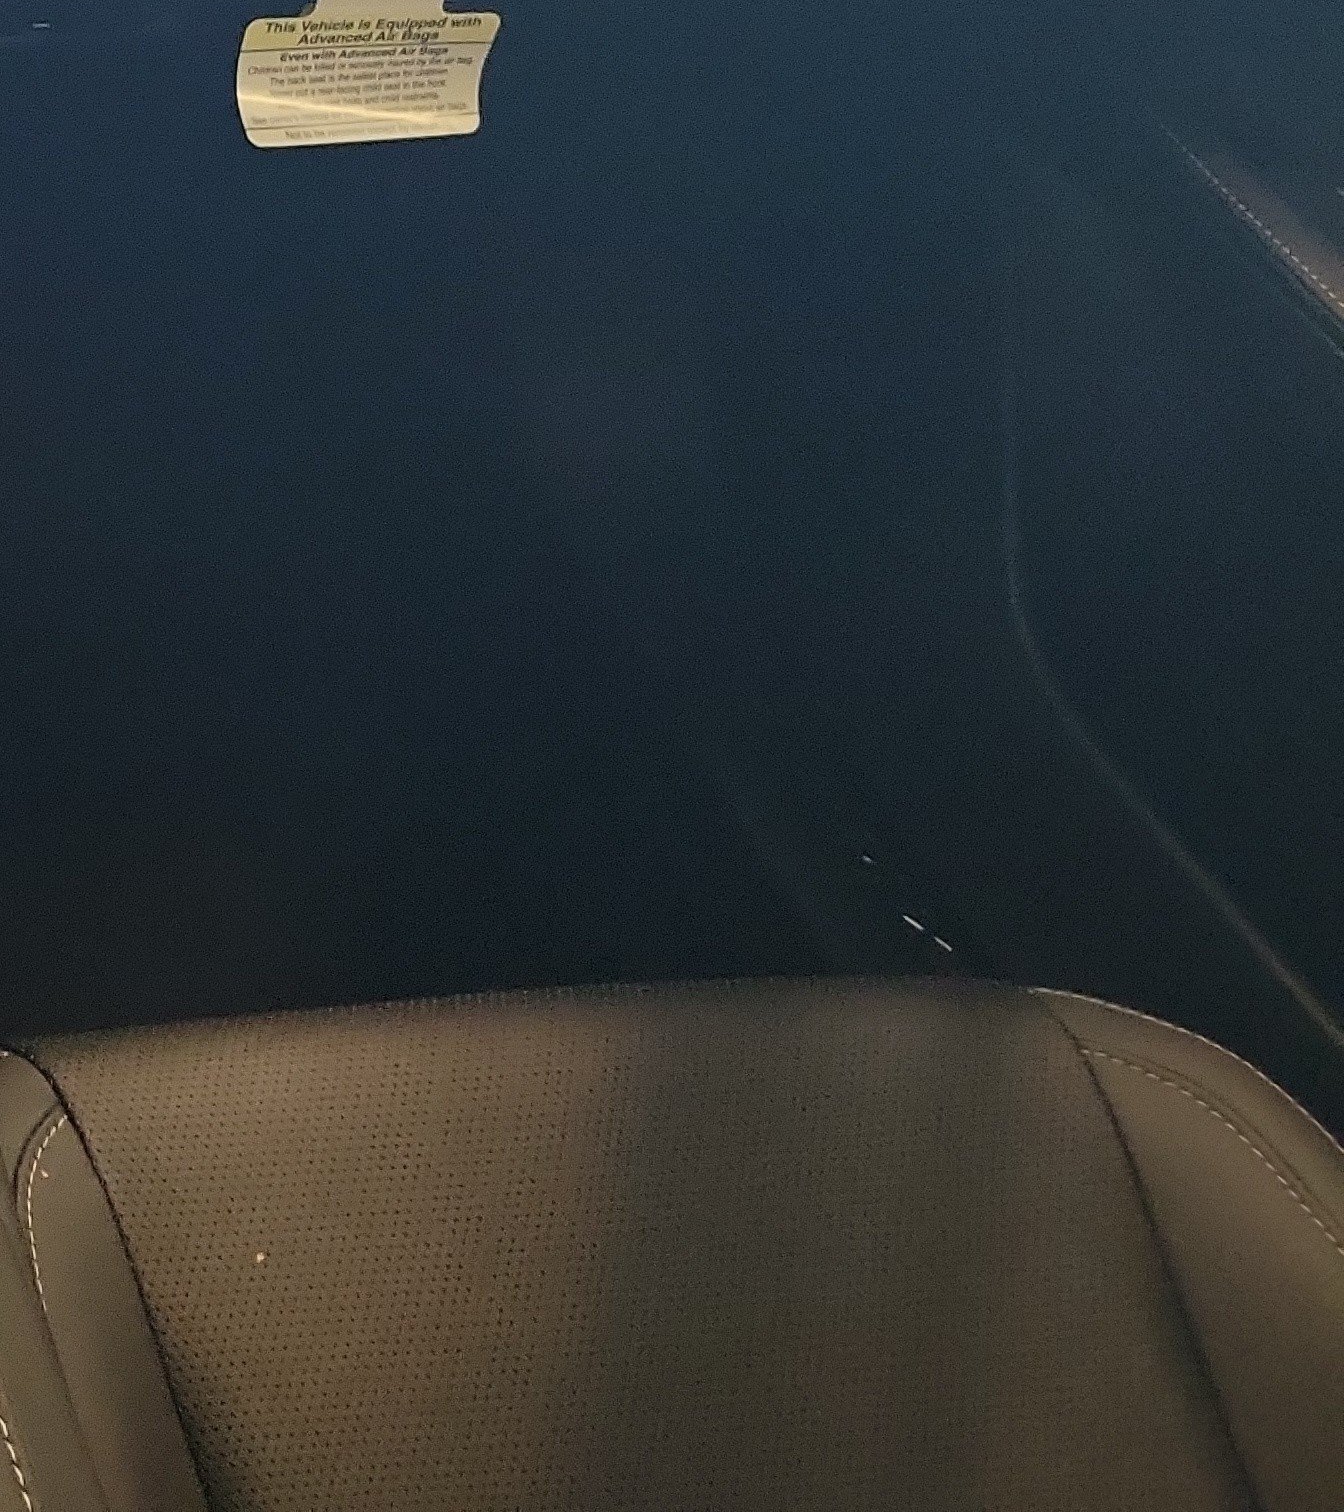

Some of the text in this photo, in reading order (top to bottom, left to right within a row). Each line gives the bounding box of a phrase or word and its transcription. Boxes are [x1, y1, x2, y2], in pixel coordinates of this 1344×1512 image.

[266, 20, 296, 34] This
[301, 19, 354, 32] Vehicle
[374, 17, 449, 33] Equipped
[450, 17, 482, 28] with
[296, 31, 439, 47] Advanced Air Bags
[279, 52, 309, 63] Even
[311, 49, 336, 60] with
